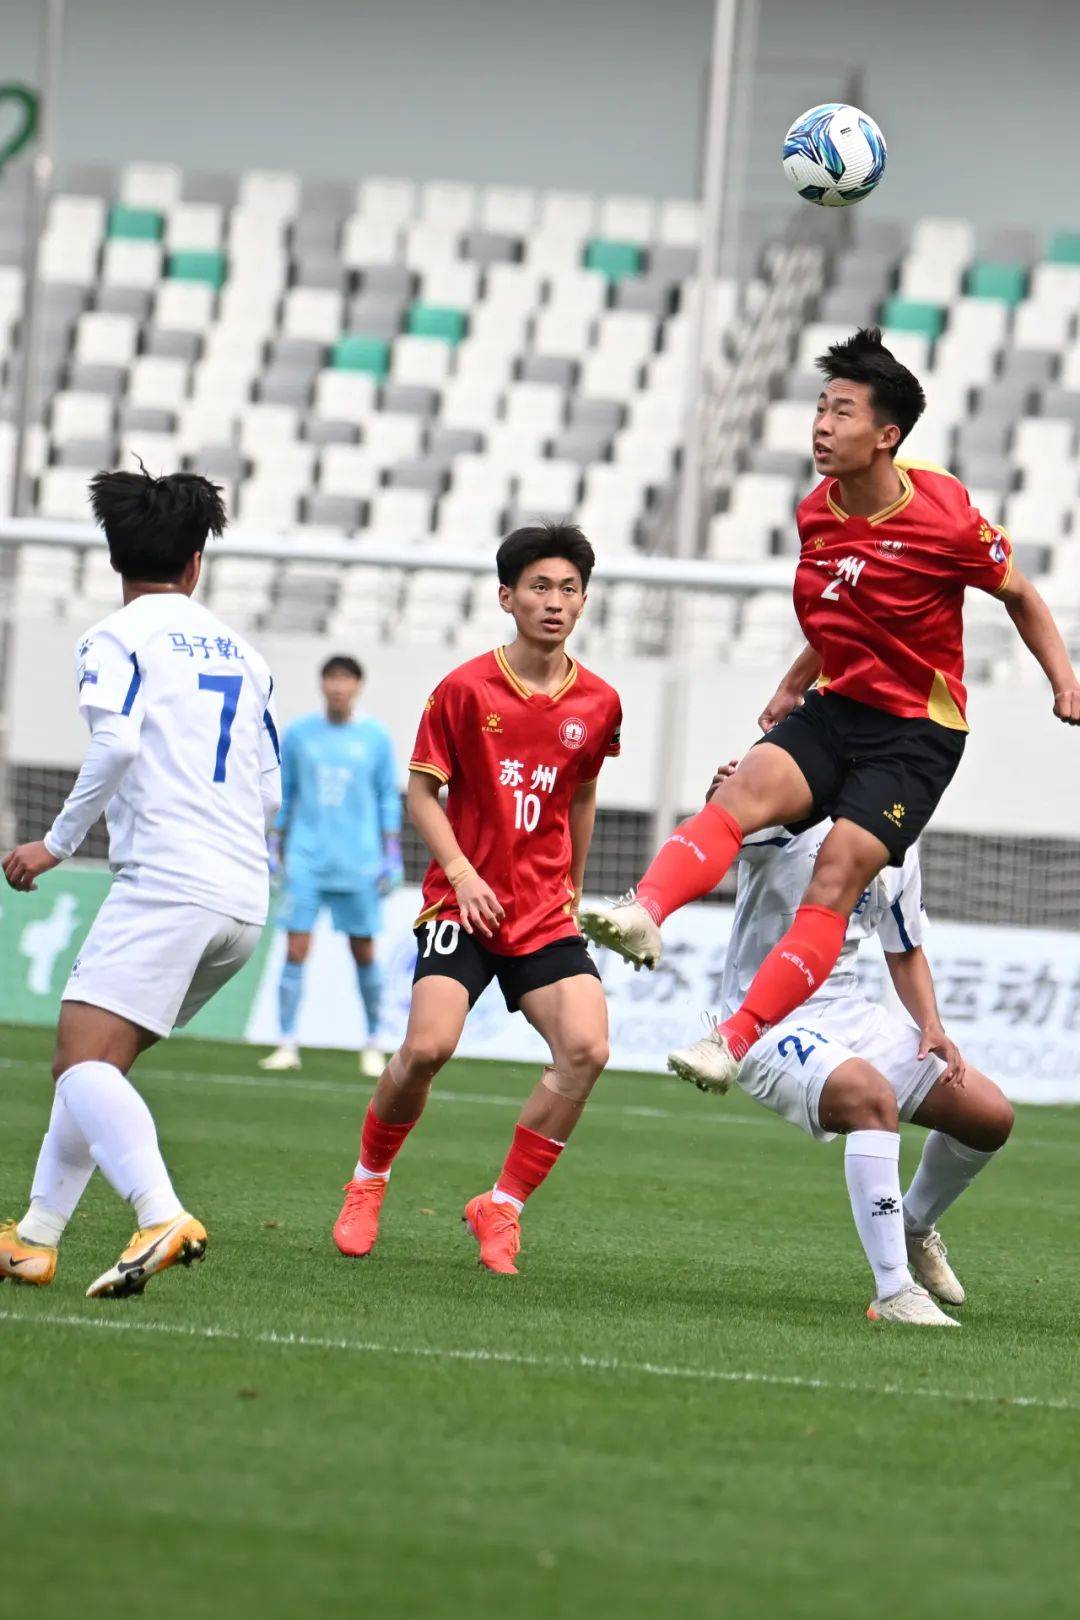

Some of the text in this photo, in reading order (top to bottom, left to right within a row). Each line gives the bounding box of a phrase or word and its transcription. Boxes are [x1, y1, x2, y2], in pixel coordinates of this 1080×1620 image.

[821, 578, 843, 601] 2
[168, 633, 245, 659] 马子乾
[198, 673, 243, 783] 7
[499, 758, 557, 793] 苏州
[513, 790, 541, 832] 10
[423, 920, 460, 958] 10
[781, 951, 815, 987] KELME
